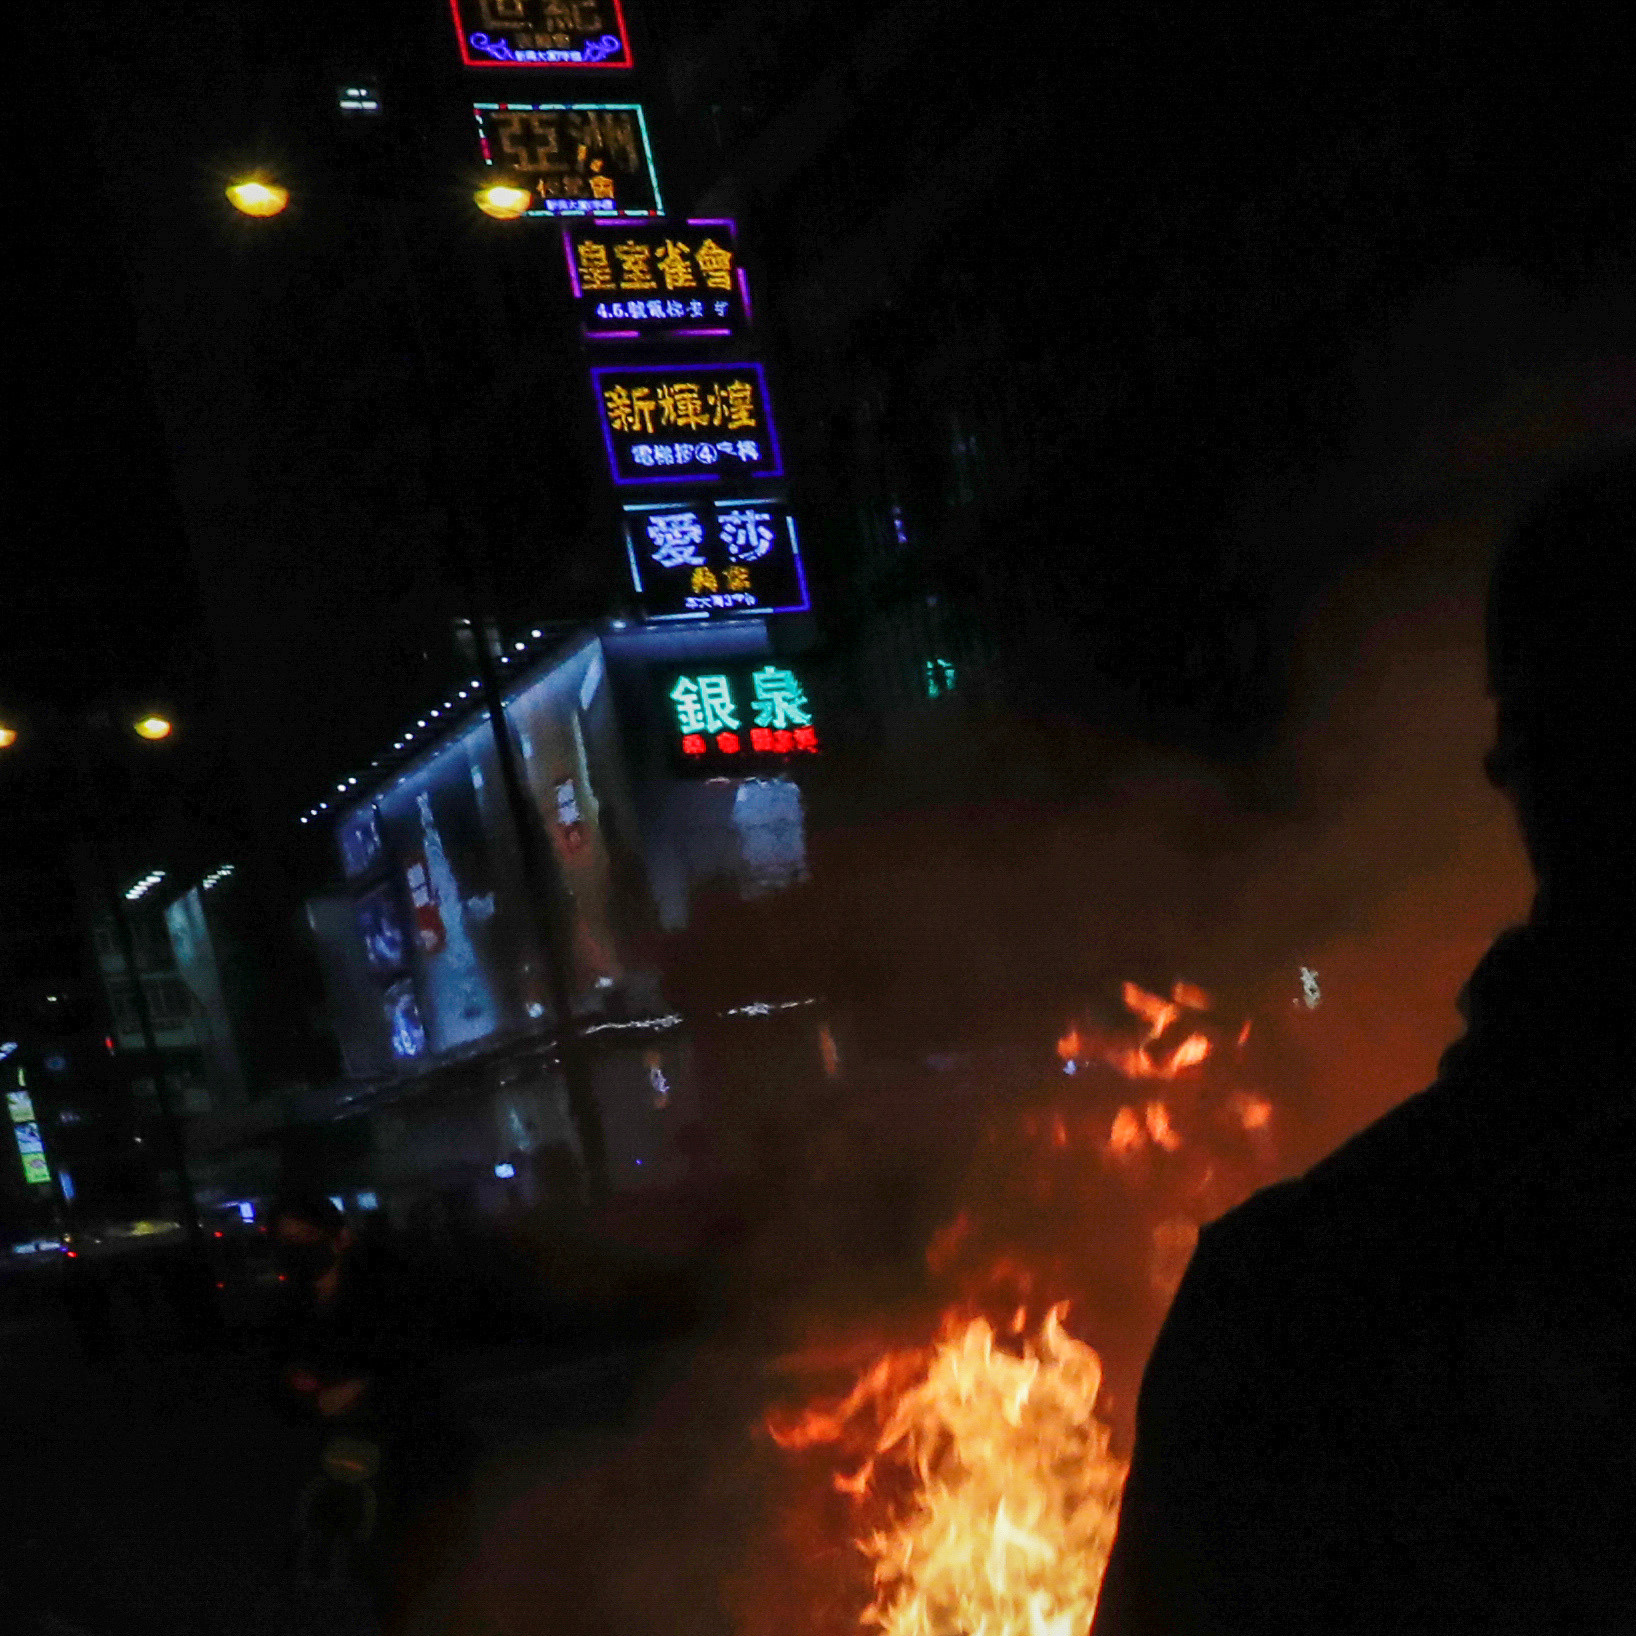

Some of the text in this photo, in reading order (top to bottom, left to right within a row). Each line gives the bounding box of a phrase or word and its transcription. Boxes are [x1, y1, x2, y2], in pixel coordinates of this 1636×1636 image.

[578, 239, 733, 291] 皇室雀會
[604, 380, 757, 434] 新輝煌
[646, 509, 776, 568] 愛莎
[670, 665, 813, 734] 銀泉
